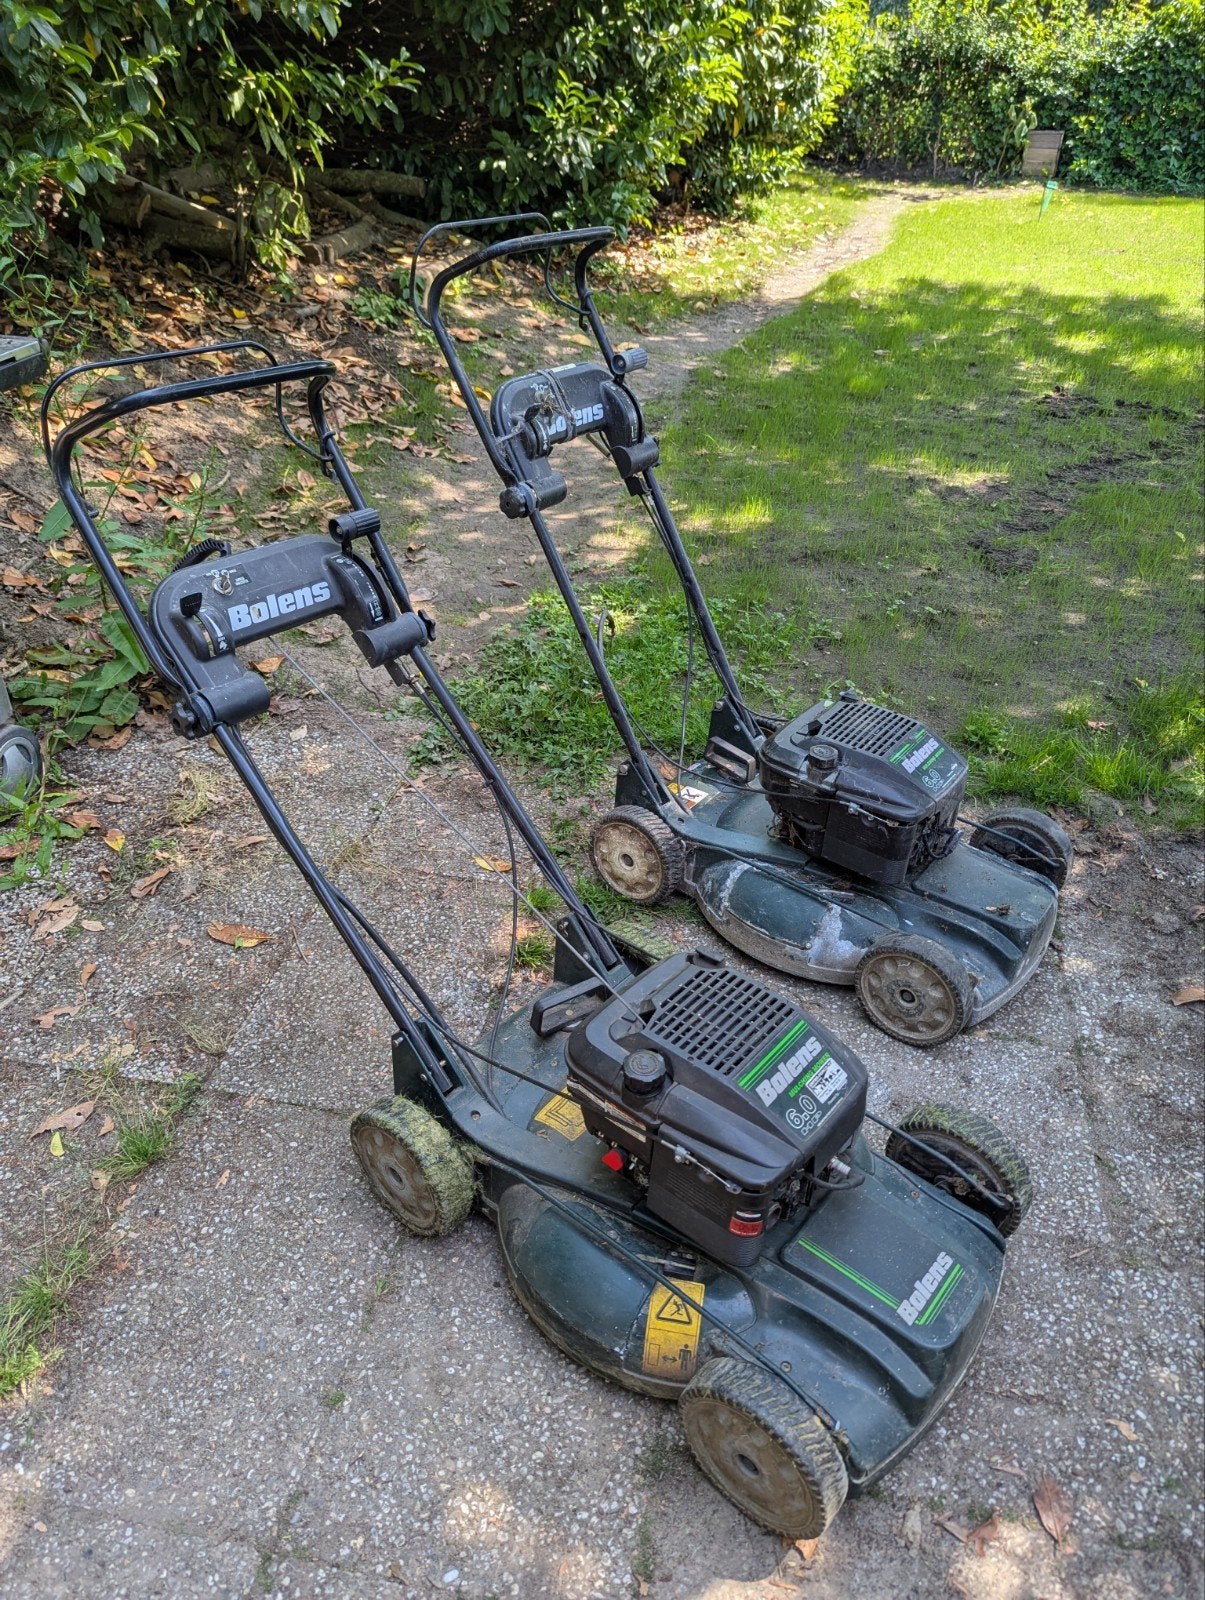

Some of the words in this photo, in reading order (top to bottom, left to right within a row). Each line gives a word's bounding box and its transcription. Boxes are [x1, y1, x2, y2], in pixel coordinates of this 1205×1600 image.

[546, 404, 604, 435] oens
[227, 581, 331, 632] Bolens
[901, 737, 939, 774] Bolens
[755, 1036, 822, 1108] Bolens
[788, 1068, 815, 1098] MULCHING
[811, 1052, 831, 1072] MOWER
[785, 1094, 817, 1129] 6.0
[896, 1251, 953, 1326] Bolens
